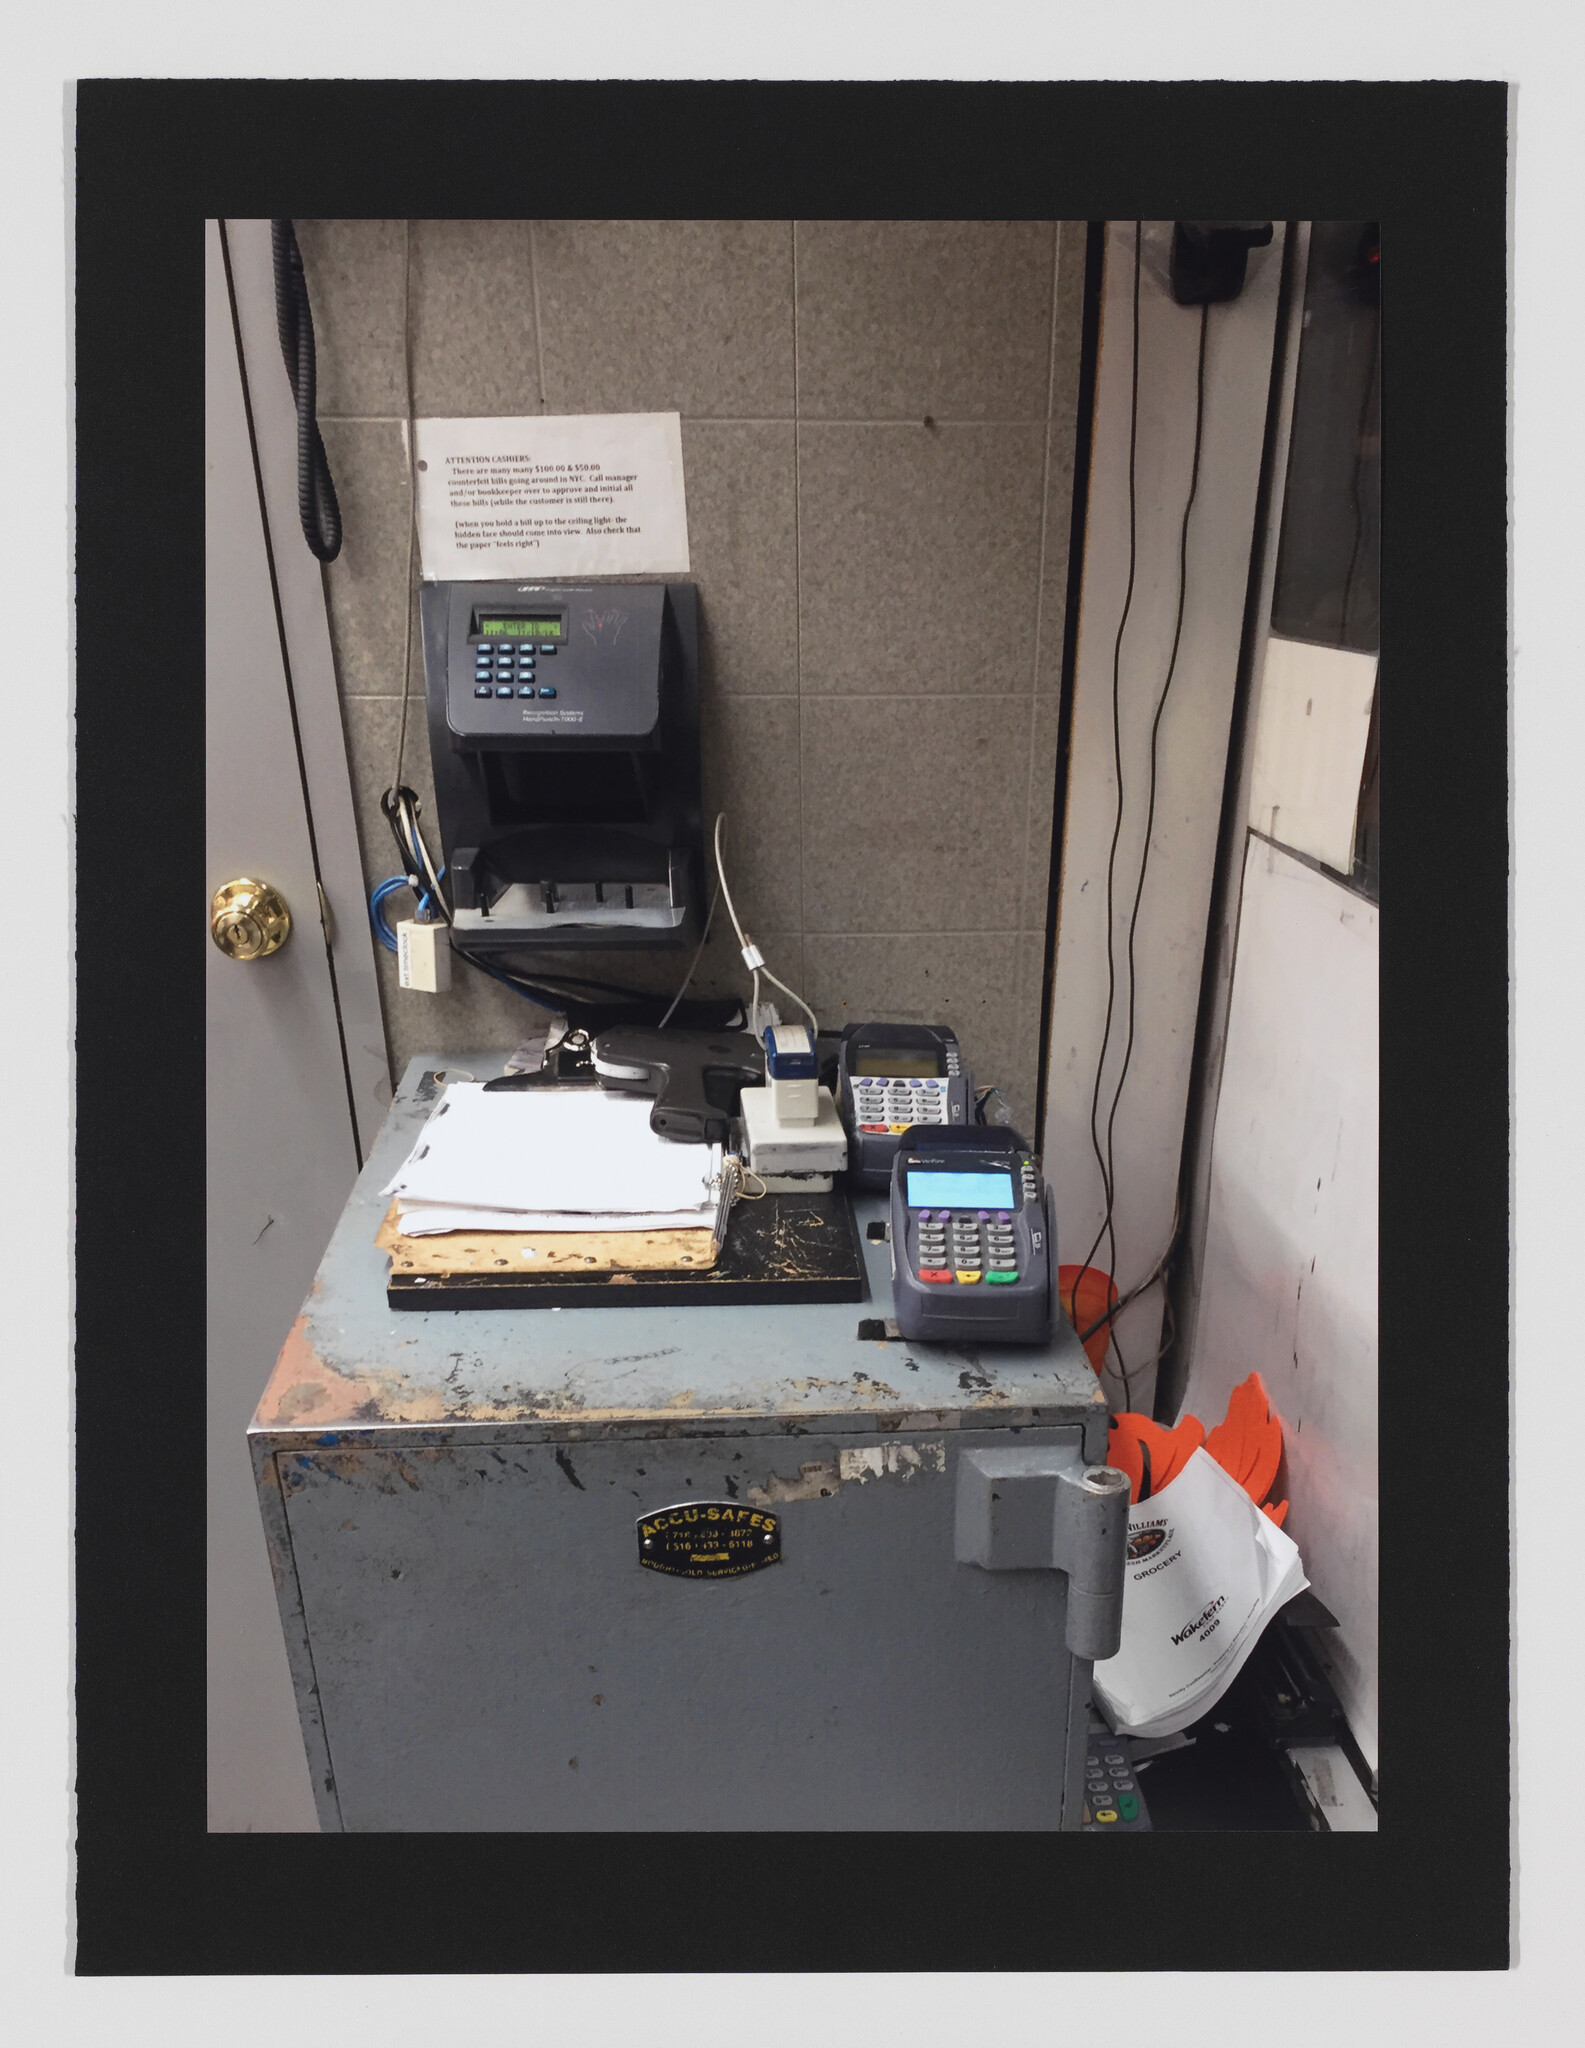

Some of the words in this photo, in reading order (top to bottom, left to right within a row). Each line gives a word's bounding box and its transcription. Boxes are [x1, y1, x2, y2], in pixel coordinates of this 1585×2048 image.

[445, 456, 490, 464] ATTENTION
[535, 465, 565, 473] $100.00
[605, 475, 638, 483] manager
[450, 489, 475, 497] and/or
[478, 488, 522, 496] bookkeeper
[552, 487, 582, 495] approve
[490, 499, 513, 507] (while
[455, 521, 479, 529] (when
[568, 517, 593, 525] ceiling
[586, 527, 602, 535] Also
[470, 542, 491, 550] paper
[516, 540, 540, 548] right")
[642, 1507, 777, 1538] ACCU-SAFES
[1134, 1550, 1182, 1581] GROCERY
[1171, 1596, 1225, 1646] Wakefern
[1200, 1619, 1221, 1642] 4009
